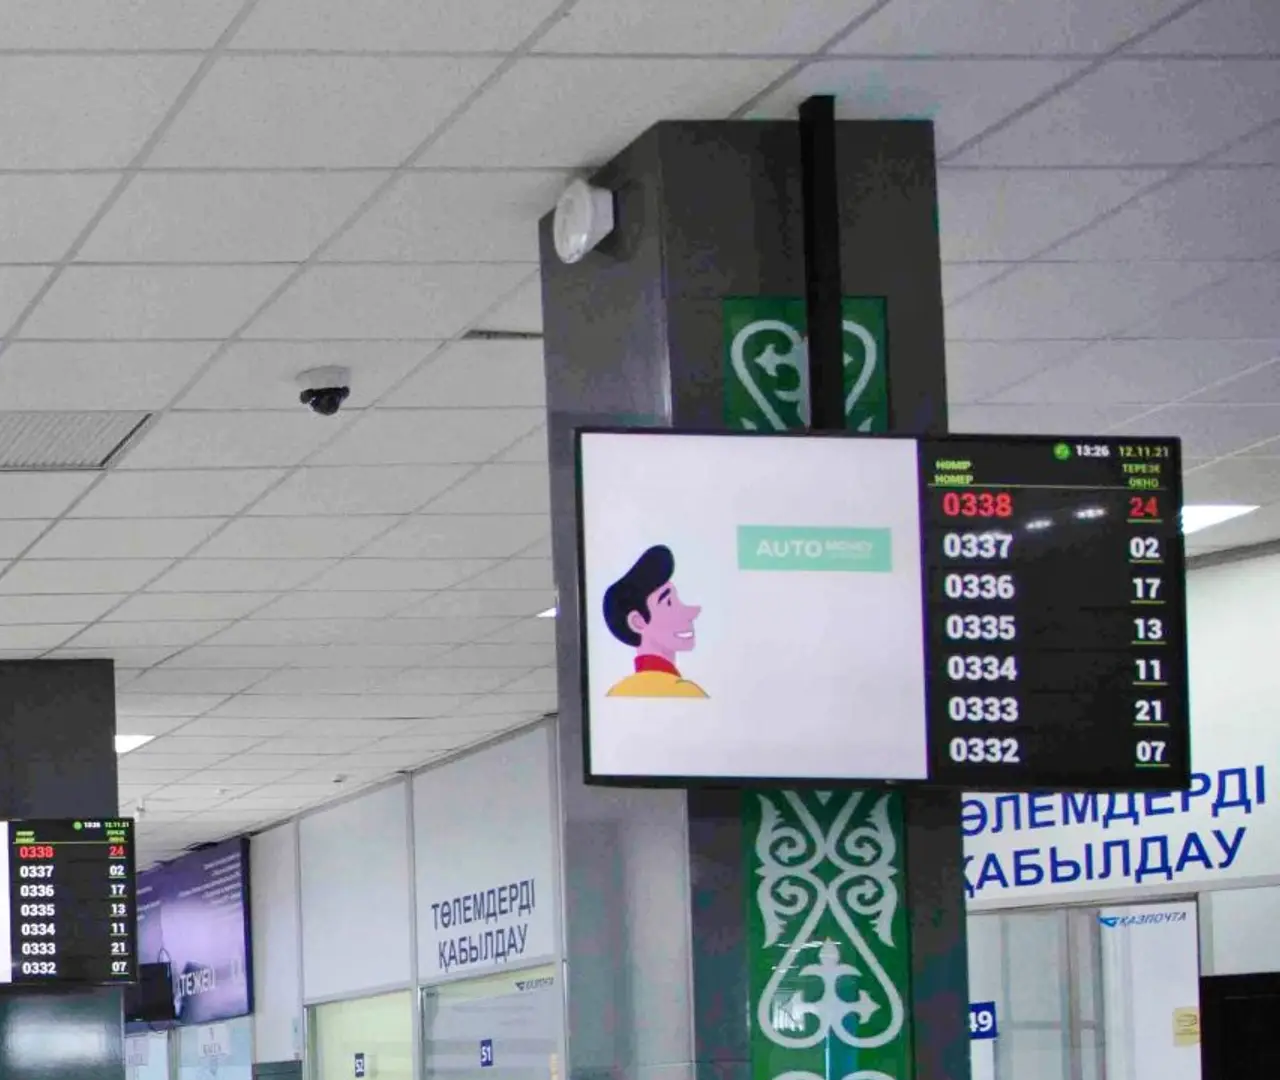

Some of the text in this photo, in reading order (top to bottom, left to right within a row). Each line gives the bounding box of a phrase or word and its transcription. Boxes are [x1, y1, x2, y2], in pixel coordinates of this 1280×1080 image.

[1075, 444, 1169, 458] 13:26 12.11.21
[943, 492, 1158, 517] 0338 24
[757, 540, 823, 558] AUTO
[943, 533, 1159, 559] 0337 02
[945, 573, 1162, 599] 0336 17
[946, 614, 1163, 640] 0335 13
[947, 656, 1162, 680] 0334 11
[948, 696, 1162, 721] 0333 21
[949, 737, 1166, 763] 0332 07
[20, 846, 124, 858] 0338 24
[20, 865, 125, 878] 0337 02
[20, 884, 126, 897] 0336 17
[21, 903, 126, 916] 0335 13
[431, 878, 535, 930] ТӨЛЕМДЕРДІ
[21, 922, 125, 936] 0334 11
[22, 942, 125, 955] 0333 21
[438, 923, 528, 973] ҚАБЫЛДАУ
[22, 961, 127, 974] 0332 07
[481, 1046, 491, 1062] 51
